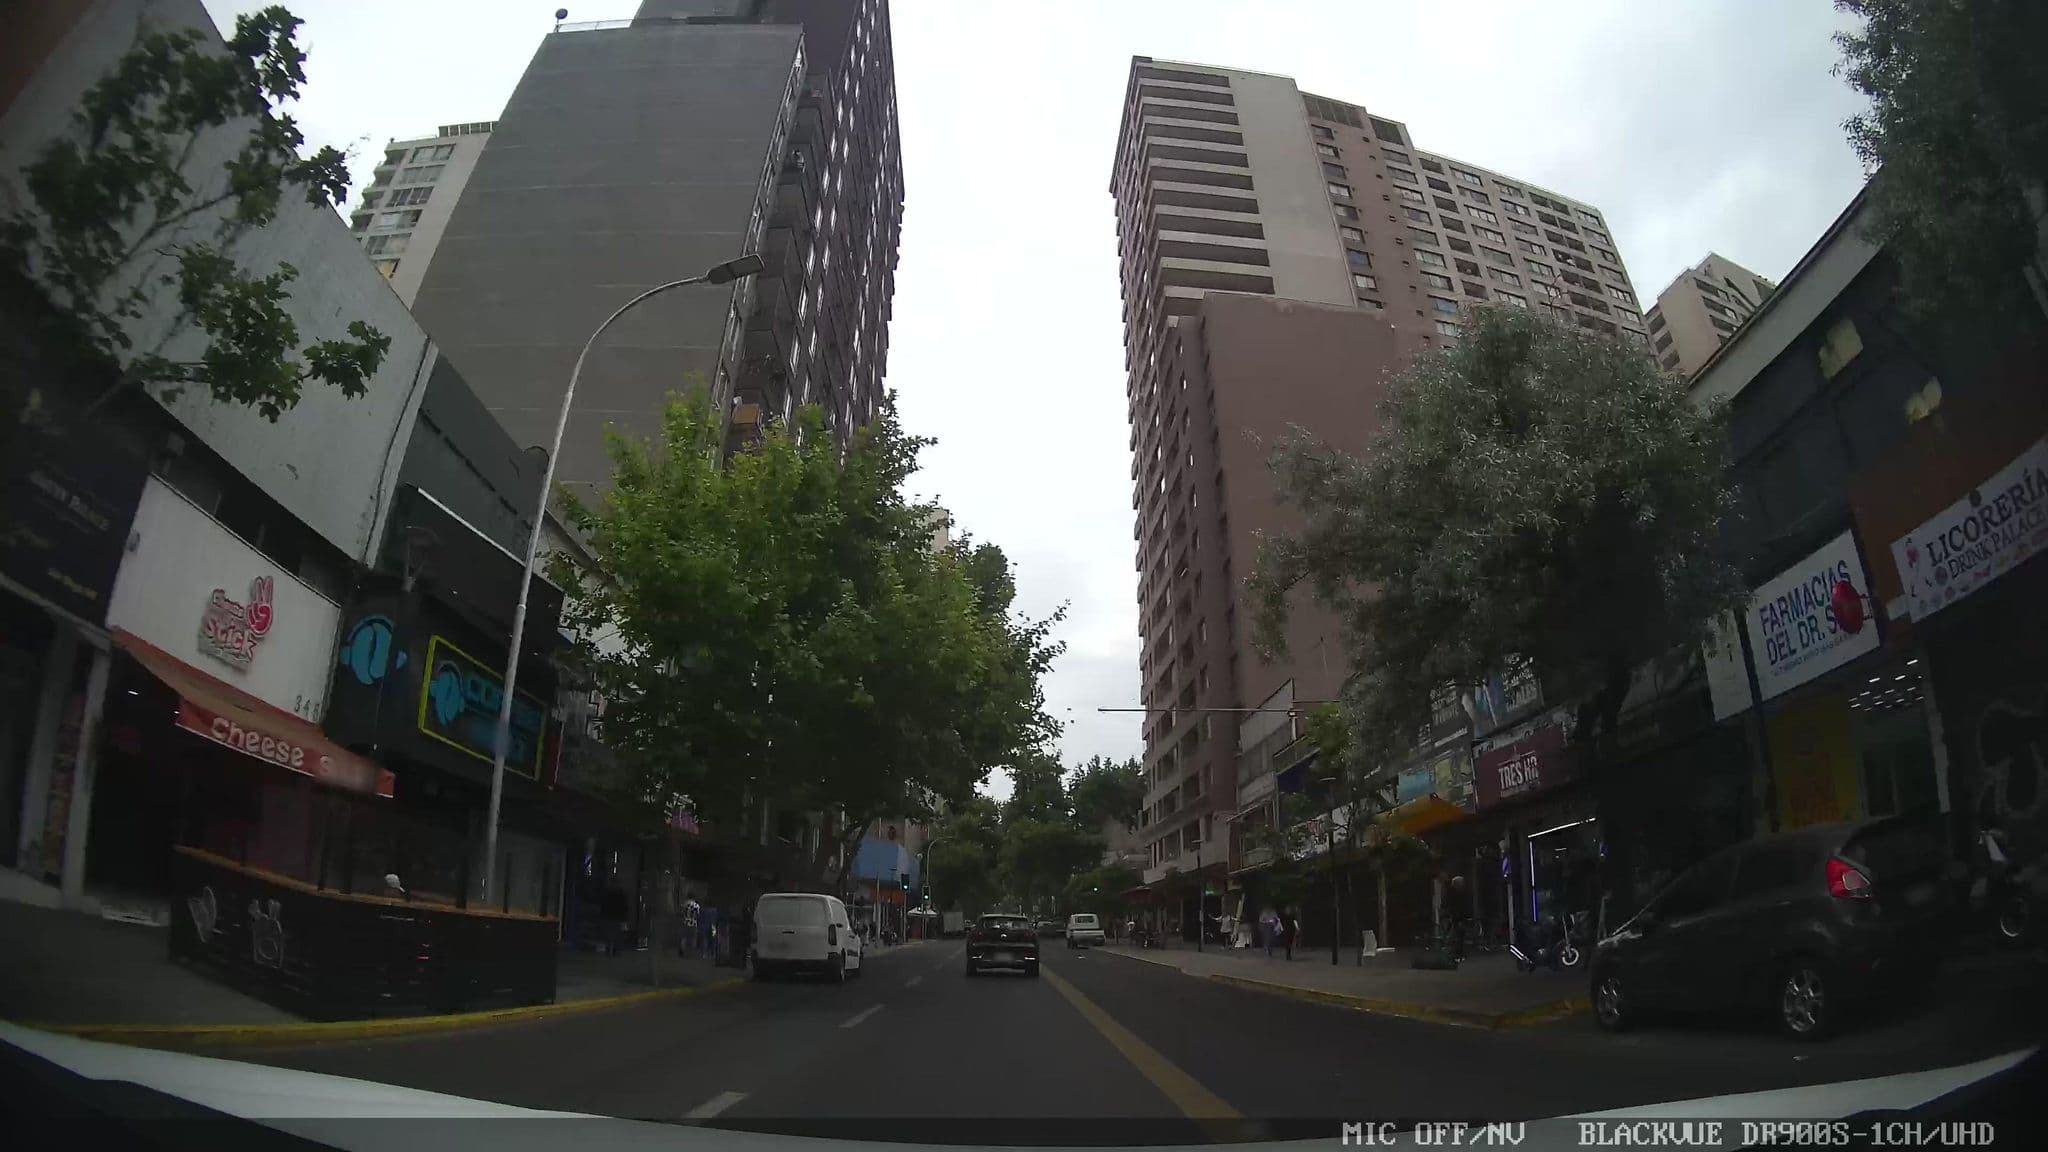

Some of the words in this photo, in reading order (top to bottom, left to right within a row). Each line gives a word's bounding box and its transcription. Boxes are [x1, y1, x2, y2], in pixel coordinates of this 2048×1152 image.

[1759, 560, 1851, 637] FARMACIAS
[1766, 629, 1797, 666] DEL
[1797, 614, 1826, 649] DR.
[1498, 761, 1523, 790] TRES
